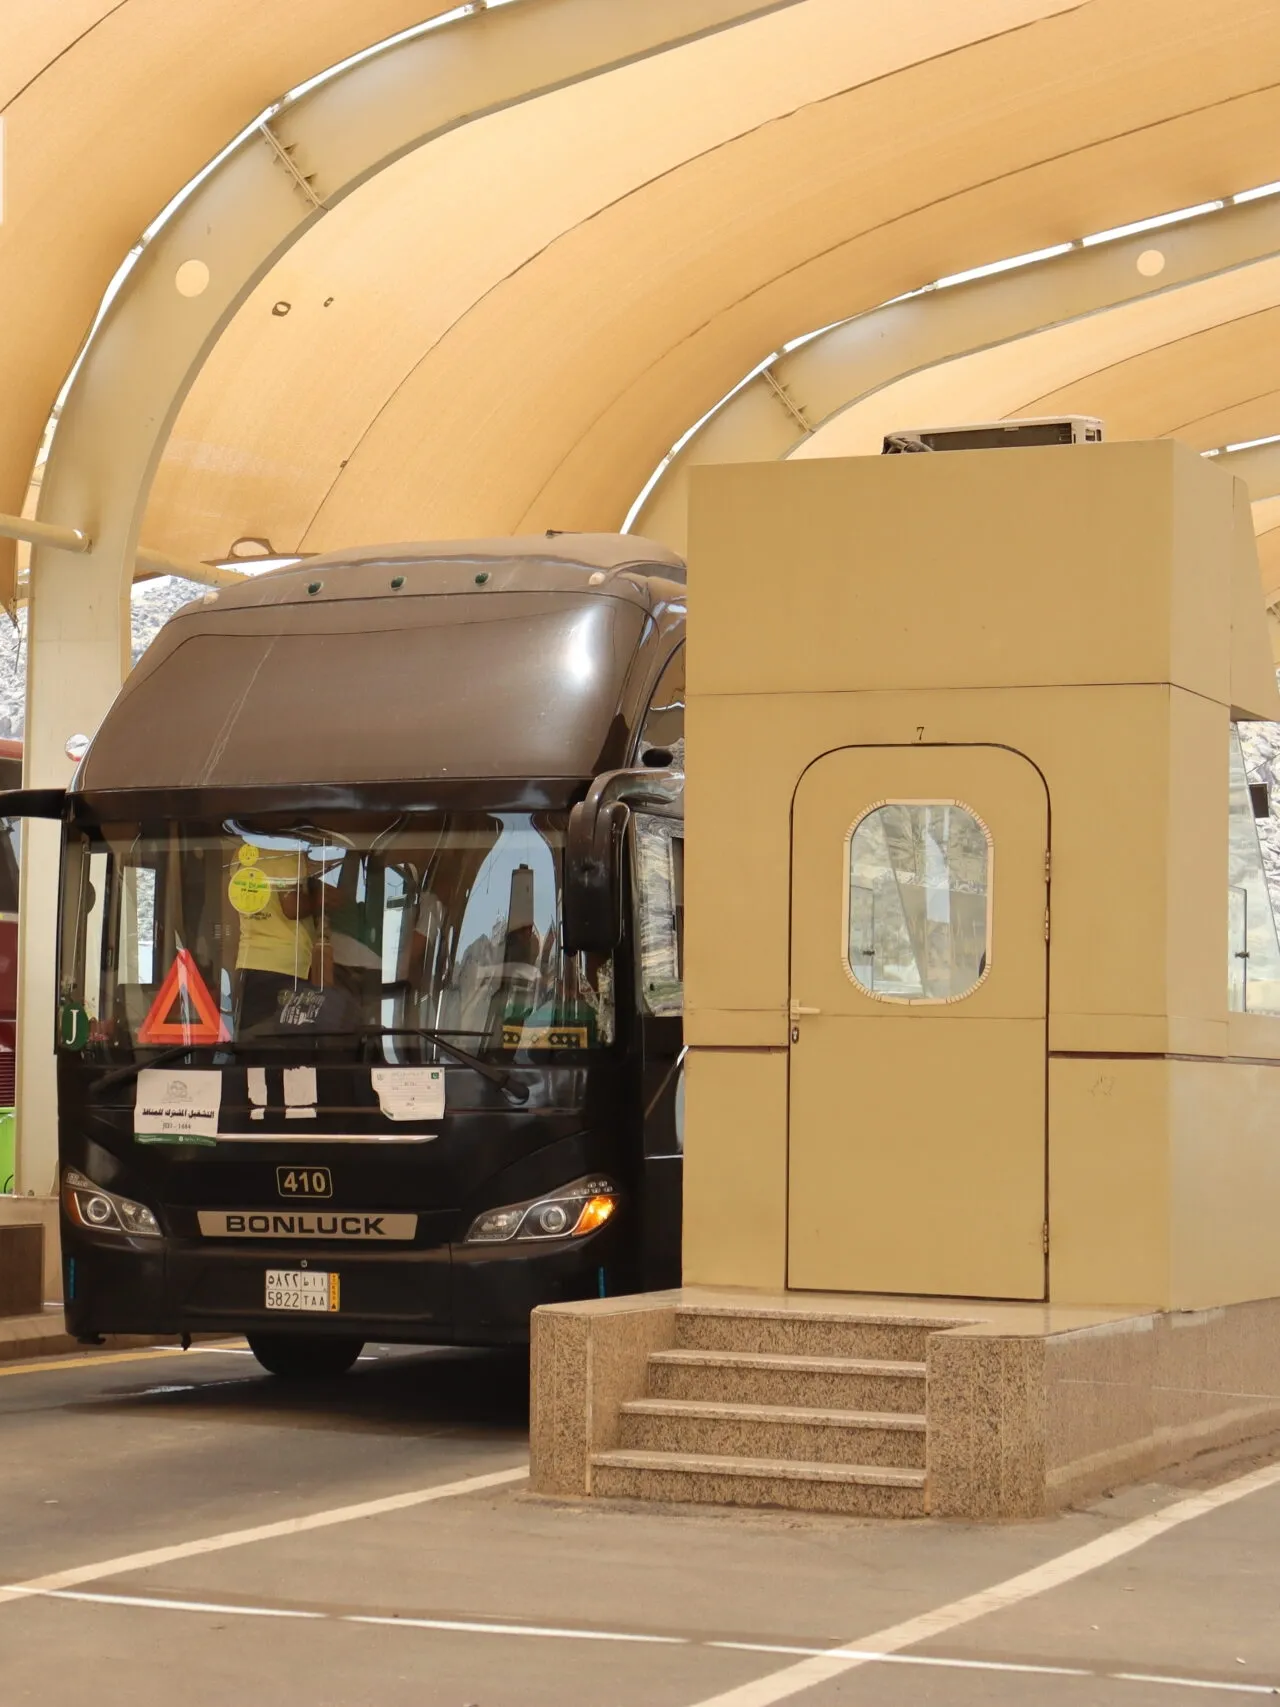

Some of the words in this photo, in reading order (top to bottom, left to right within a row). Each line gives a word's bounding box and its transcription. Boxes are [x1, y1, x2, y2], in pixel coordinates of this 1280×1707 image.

[916, 726, 925, 741] 7
[65, 1009, 80, 1045] J
[284, 1172, 326, 1193] 410
[226, 1215, 387, 1236] BONLUCK
[268, 1273, 299, 1288] ٥٨٢٢
[267, 1291, 299, 1308] 5822
[303, 1295, 325, 1306] TAA
